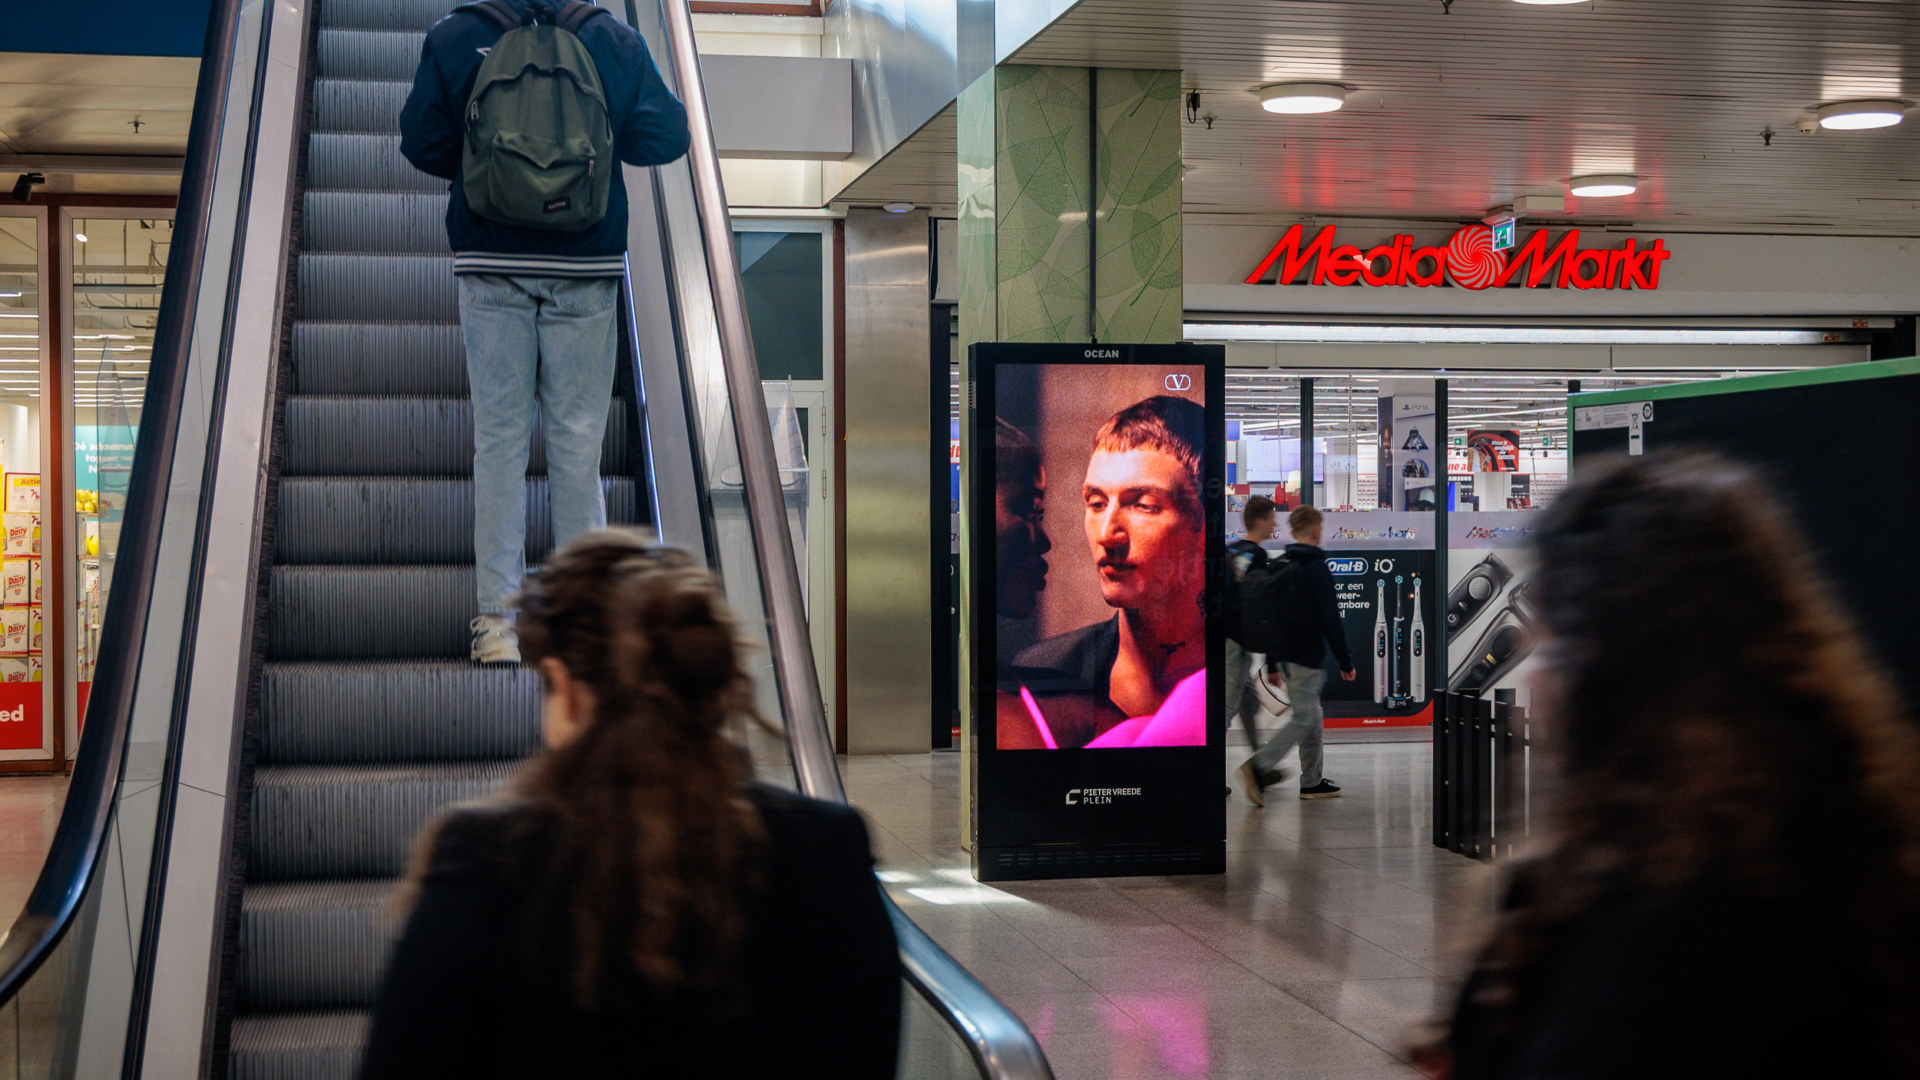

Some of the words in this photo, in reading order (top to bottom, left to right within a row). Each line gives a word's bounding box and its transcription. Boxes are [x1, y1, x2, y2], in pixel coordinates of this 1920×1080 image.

[1084, 350, 1119, 358] OCEAN
[1328, 561, 1363, 572] Oral-B
[1084, 788, 1111, 796] PIETER
[1112, 787, 1141, 796] VREEDE
[1084, 797, 1111, 805] PLEIN
